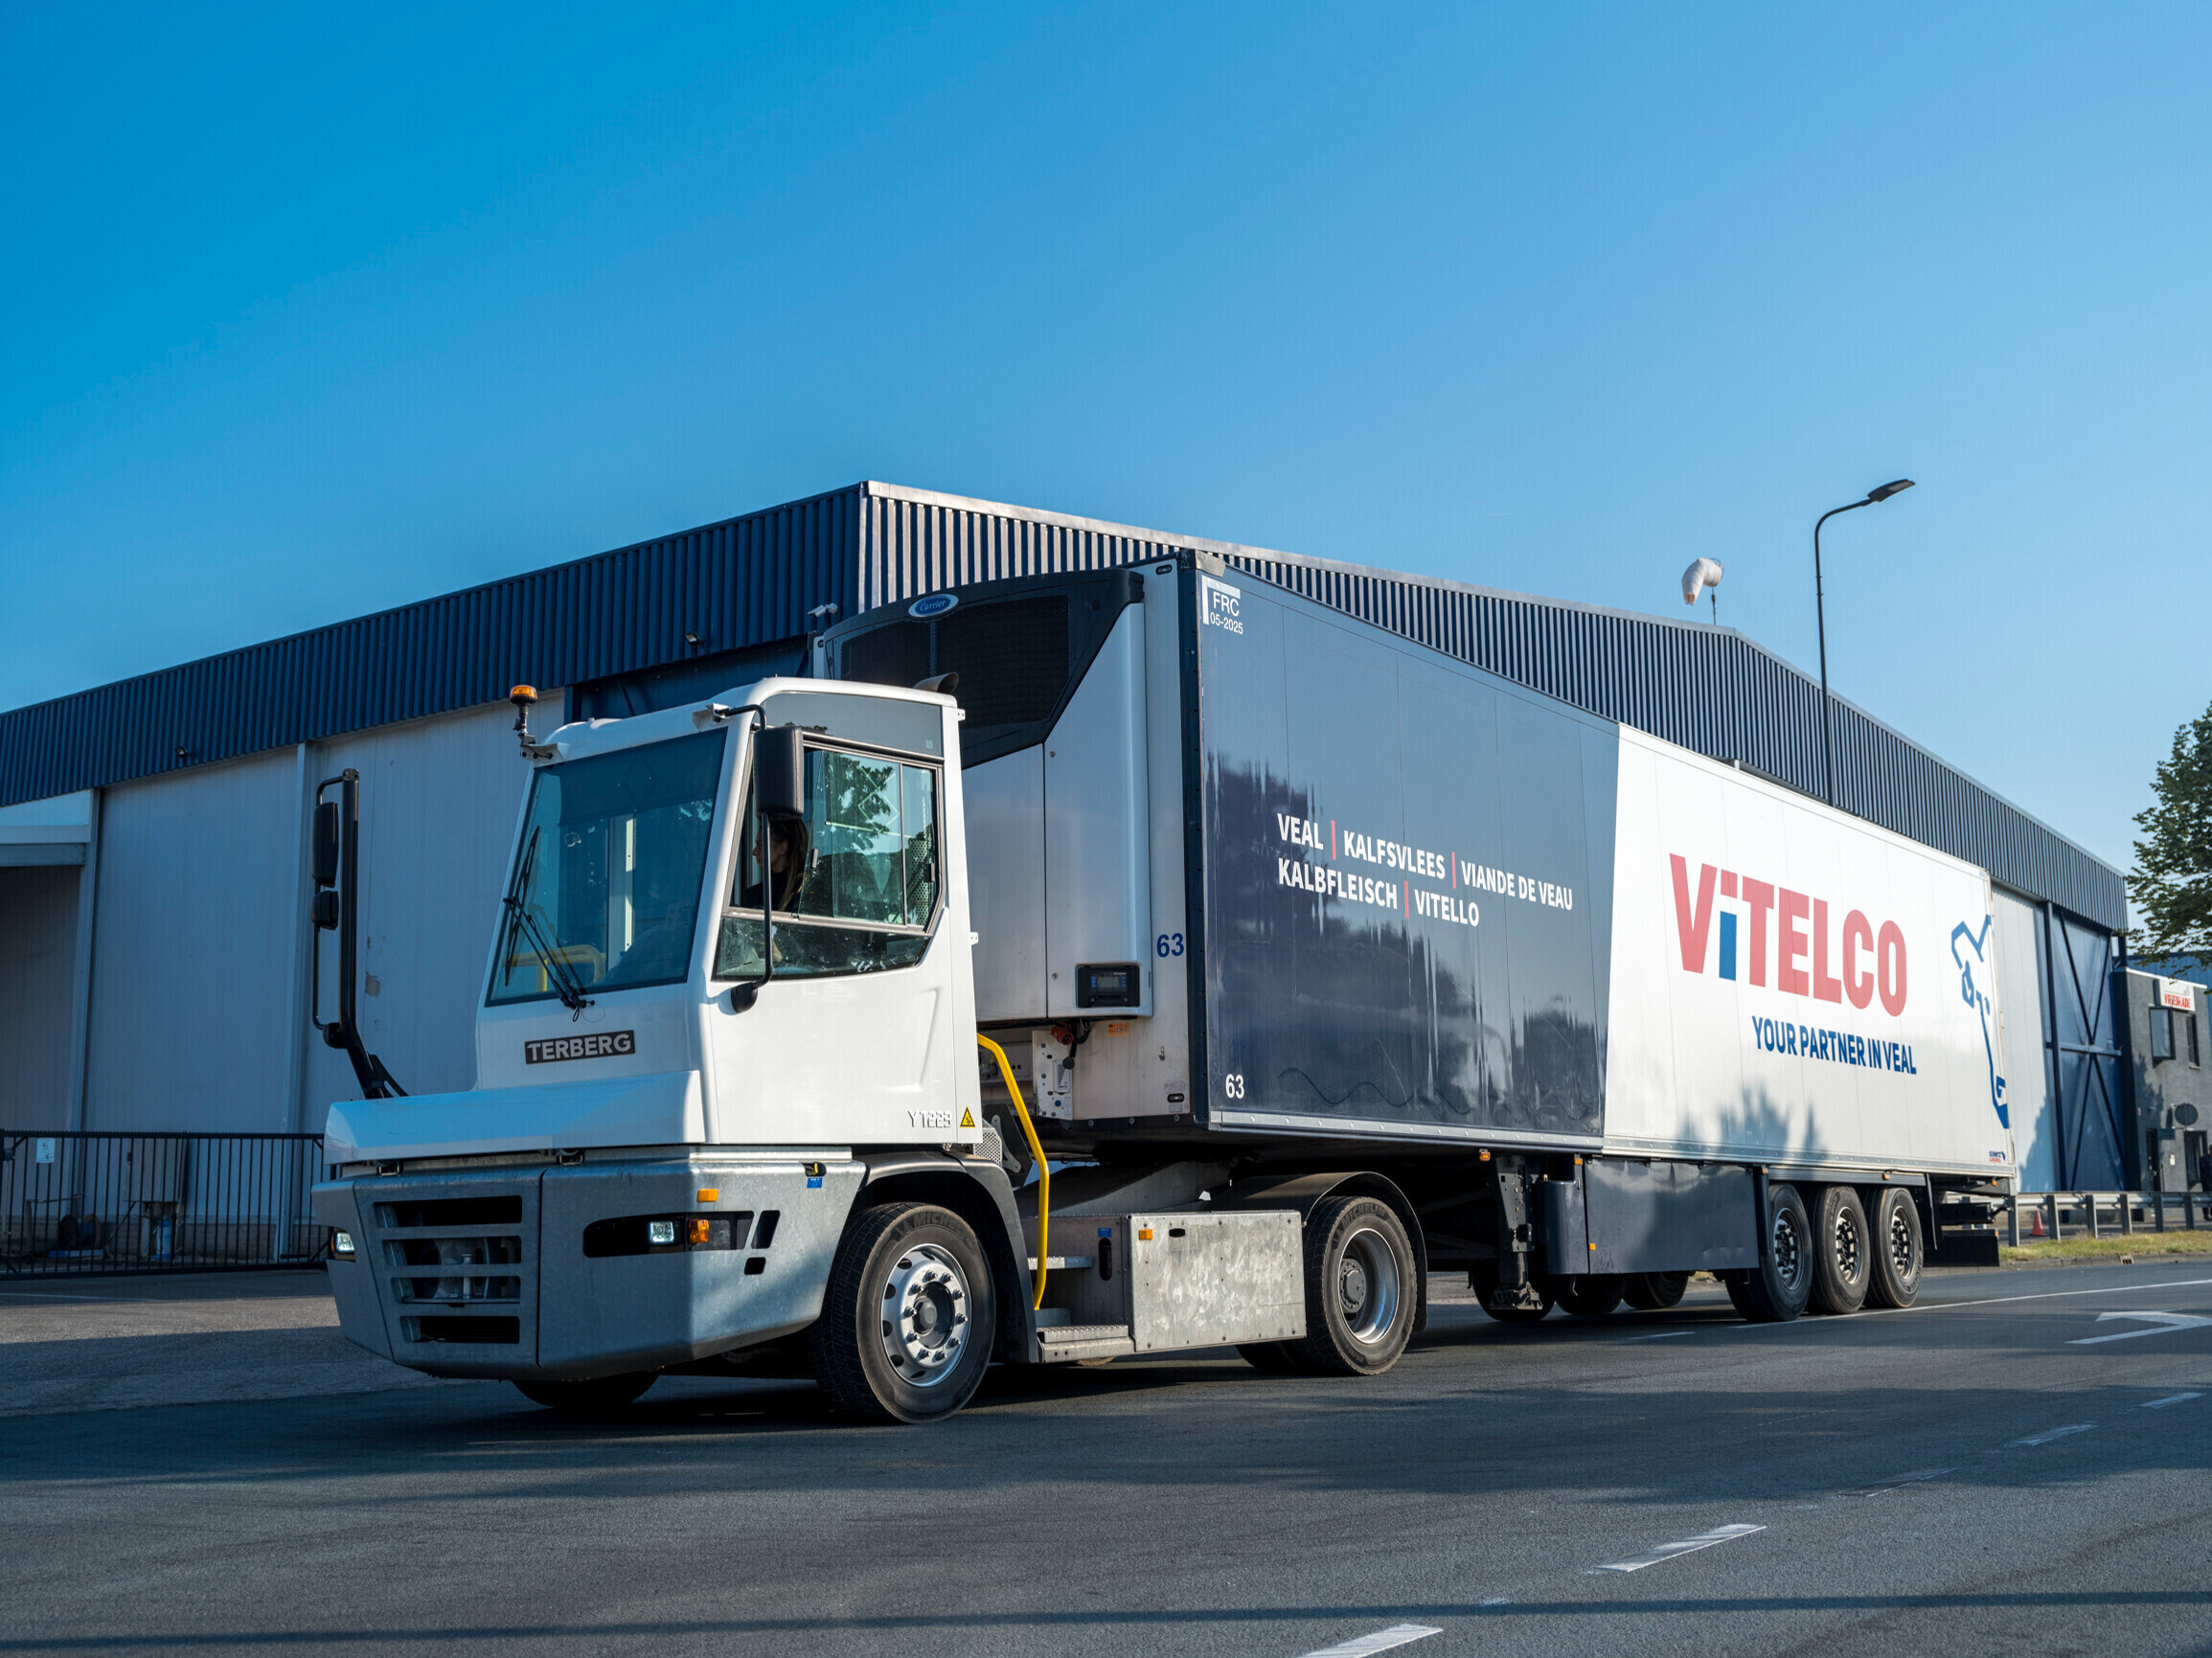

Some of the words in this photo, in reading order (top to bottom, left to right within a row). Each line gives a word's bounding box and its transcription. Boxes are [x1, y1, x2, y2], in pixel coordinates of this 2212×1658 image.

[920, 600, 946, 612] Carrier
[1213, 590, 1240, 617] FRC
[1210, 611, 1243, 635] 05-2025
[1277, 812, 1324, 851] VEAL
[1343, 829, 1446, 880] KALFSVLEES
[1460, 860, 1516, 897] VIANDE
[1517, 875, 1537, 902] DE
[1538, 880, 1573, 911] VEAU
[1278, 856, 1398, 910] KALBFLEISCH
[1414, 889, 1480, 927] VITELLO
[1156, 932, 1185, 958] 63
[526, 1033, 632, 1062] TERBERG
[1751, 1015, 1798, 1056] YOUR
[1799, 1025, 1866, 1067] PARTNER
[1867, 1037, 1882, 1070] IN
[1881, 1040, 1917, 1076] VEAL
[1225, 1073, 1245, 1100] 63
[907, 1110, 952, 1129] YT223
